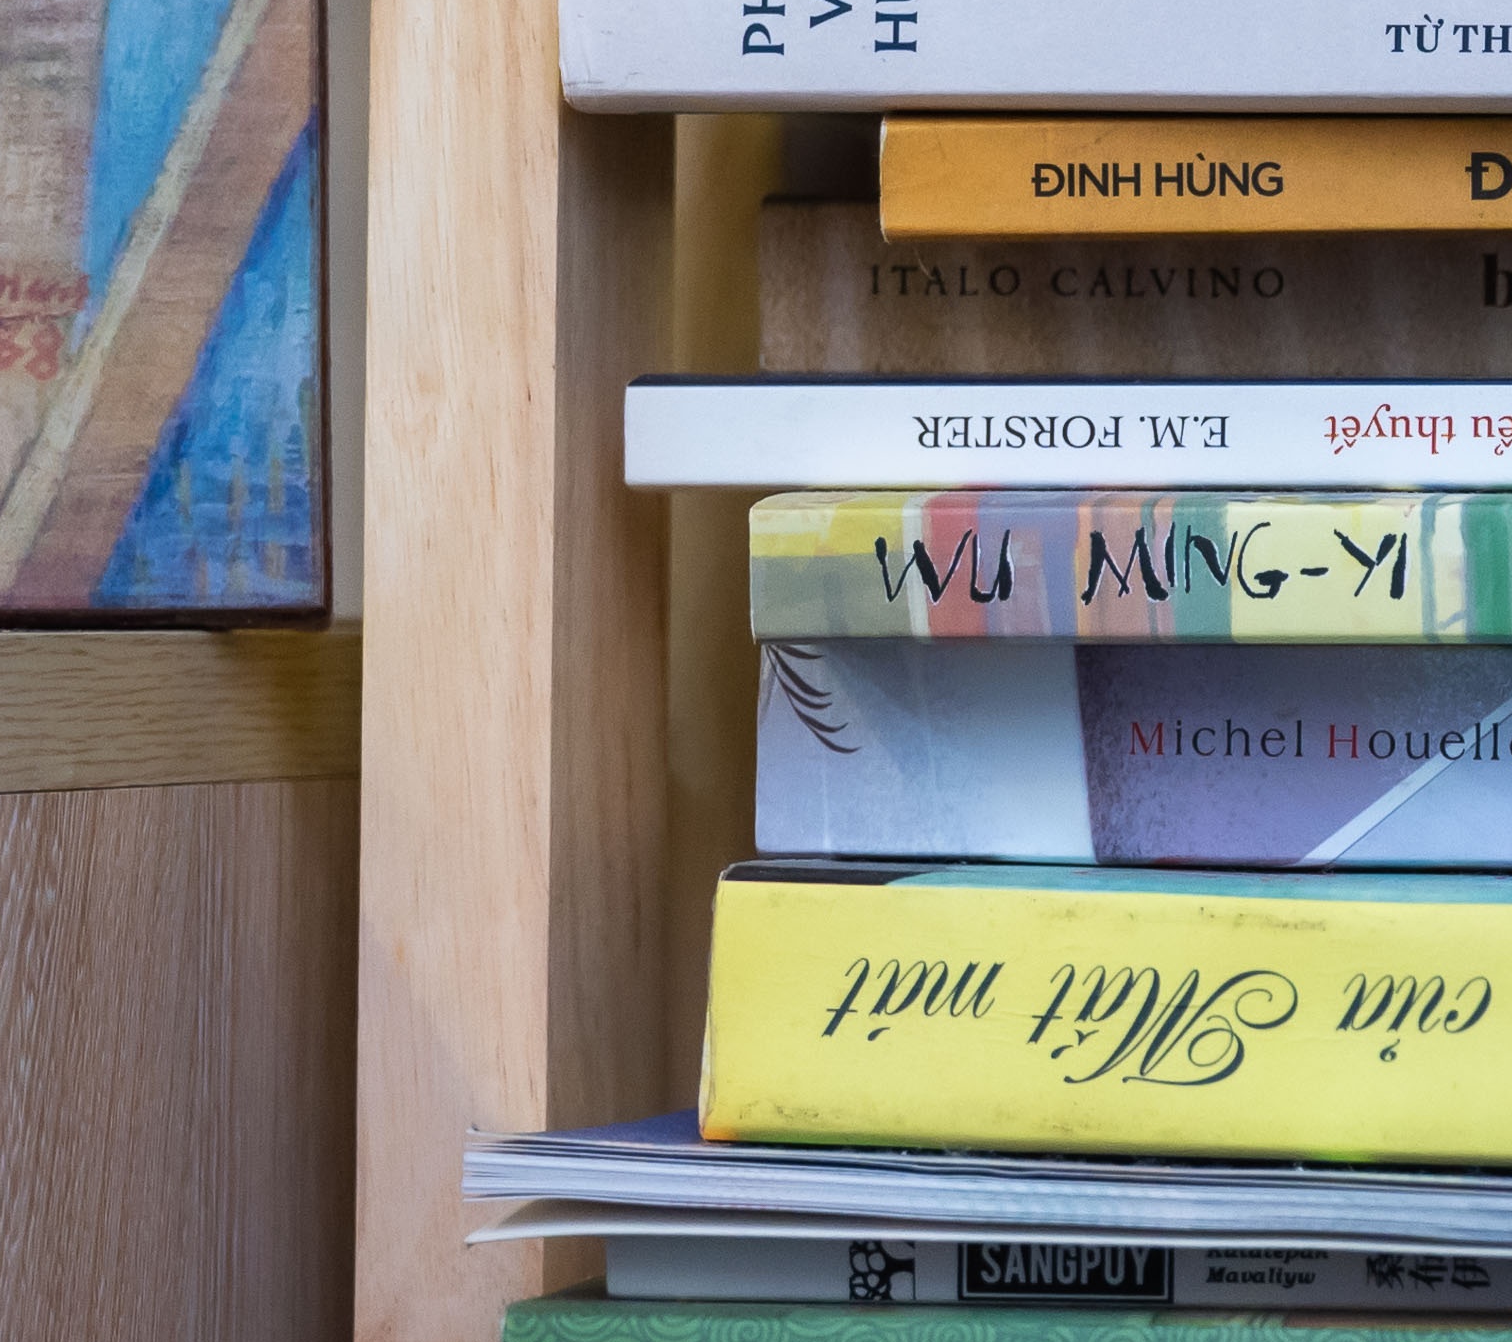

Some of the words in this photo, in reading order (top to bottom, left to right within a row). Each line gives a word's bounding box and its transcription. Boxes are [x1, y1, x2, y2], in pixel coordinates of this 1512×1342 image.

[1386, 15, 1440, 55] TỪ
[1032, 161, 1142, 198] ĐINH
[1154, 152, 1285, 197] HÙNG
[869, 265, 1022, 298] ITALO
[1049, 266, 1285, 299] CALVINO
[914, 414, 1122, 450] FORSTER
[1138, 414, 1230, 450] E.M.
[1324, 404, 1459, 456] thuyết
[874, 529, 1013, 604] WU
[1082, 522, 1408, 606] MING-YI
[1128, 718, 1305, 759] Michel
[823, 957, 1003, 1042] mát
[1336, 973, 1492, 1062] của
[1031, 959, 1299, 1088] Mất
[980, 1244, 1152, 1286] SANGPUY
